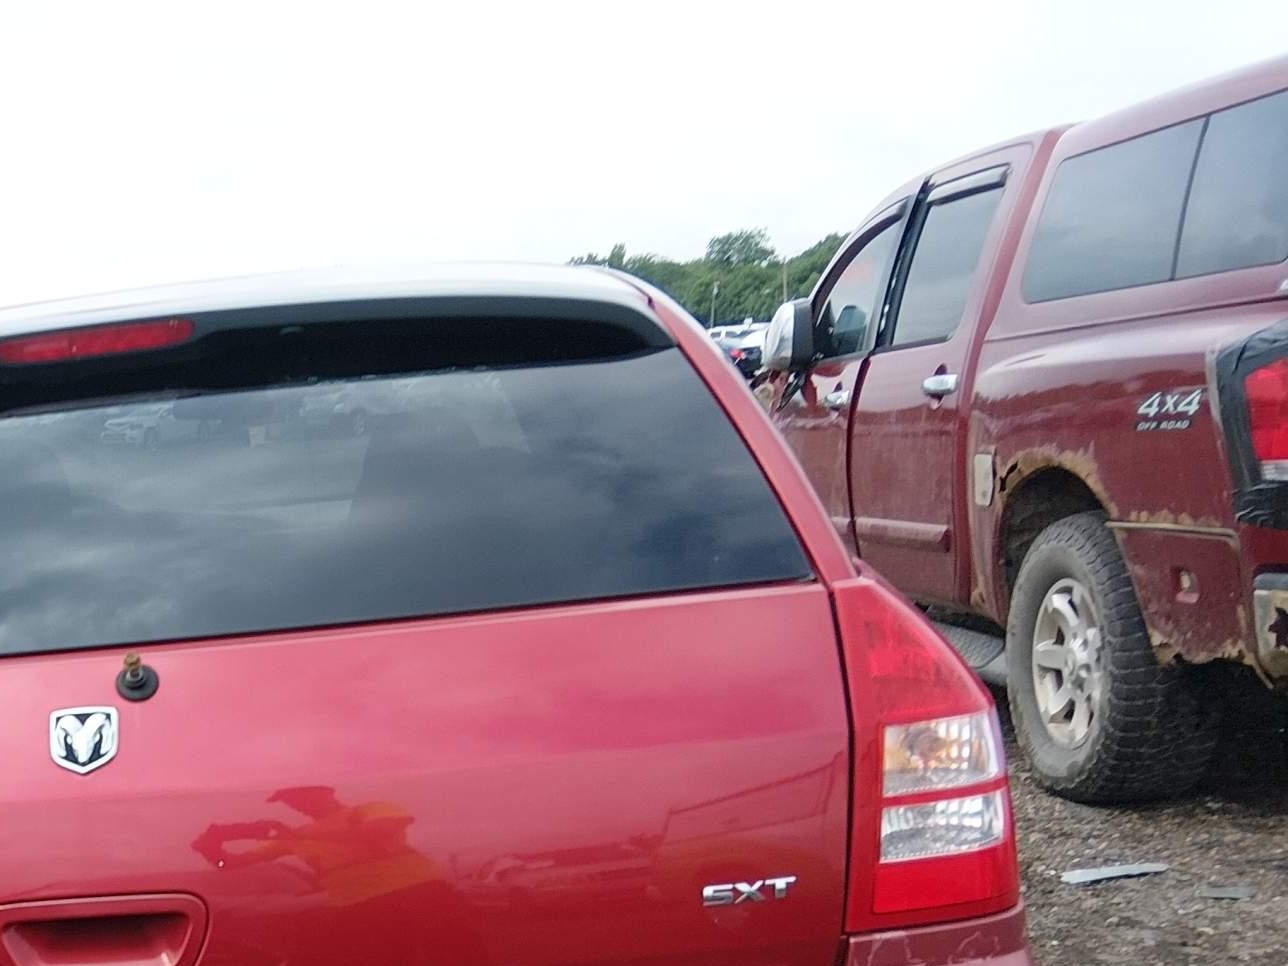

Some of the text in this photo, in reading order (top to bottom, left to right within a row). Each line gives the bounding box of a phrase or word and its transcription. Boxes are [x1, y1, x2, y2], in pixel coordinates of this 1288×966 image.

[1135, 419, 1191, 432] OFF ROAD
[702, 875, 797, 907] SXT
